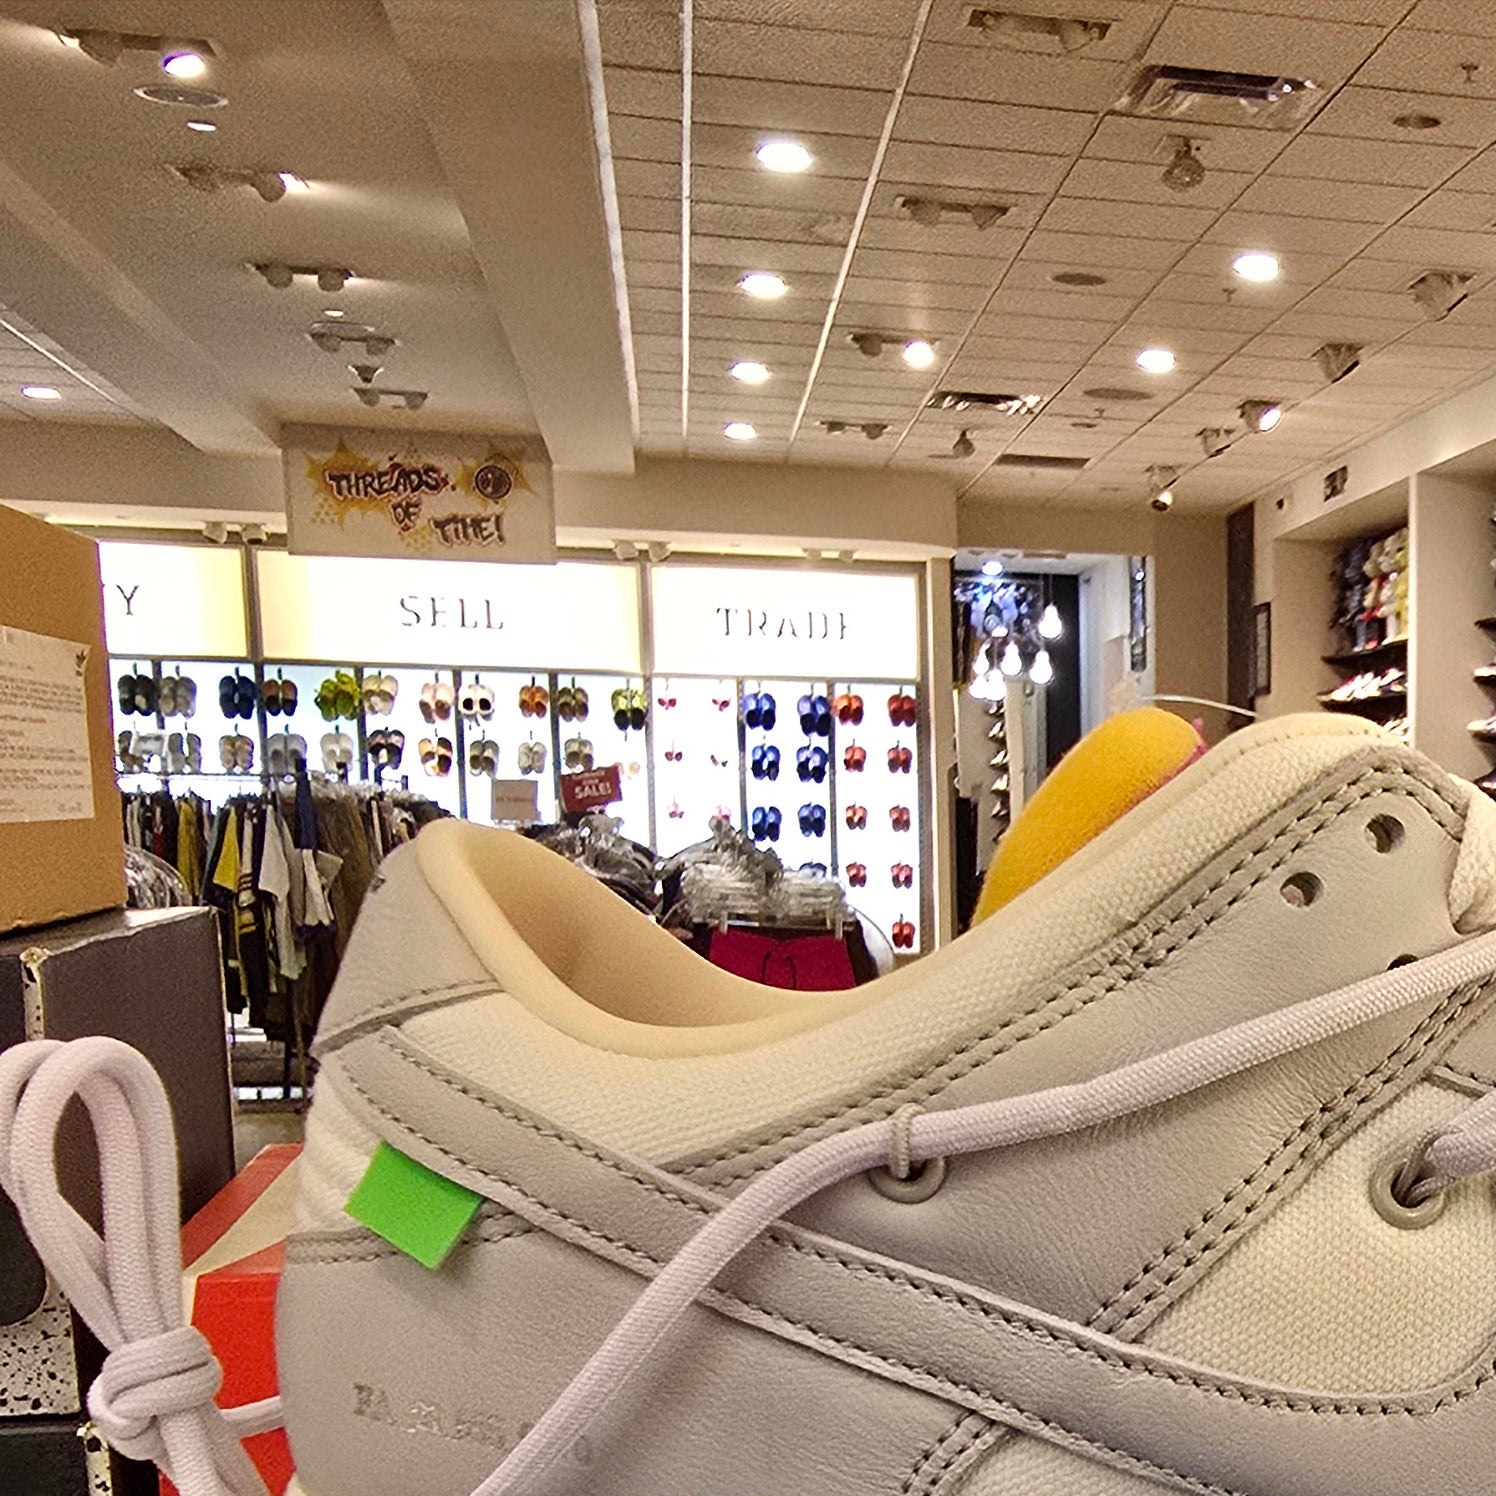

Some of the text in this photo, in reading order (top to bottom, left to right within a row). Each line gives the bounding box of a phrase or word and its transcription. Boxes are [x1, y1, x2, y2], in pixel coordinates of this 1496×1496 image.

[327, 462, 446, 498] THREADS
[391, 500, 420, 526] OF
[399, 595, 504, 630] SELL
[574, 781, 613, 800] SALE!
